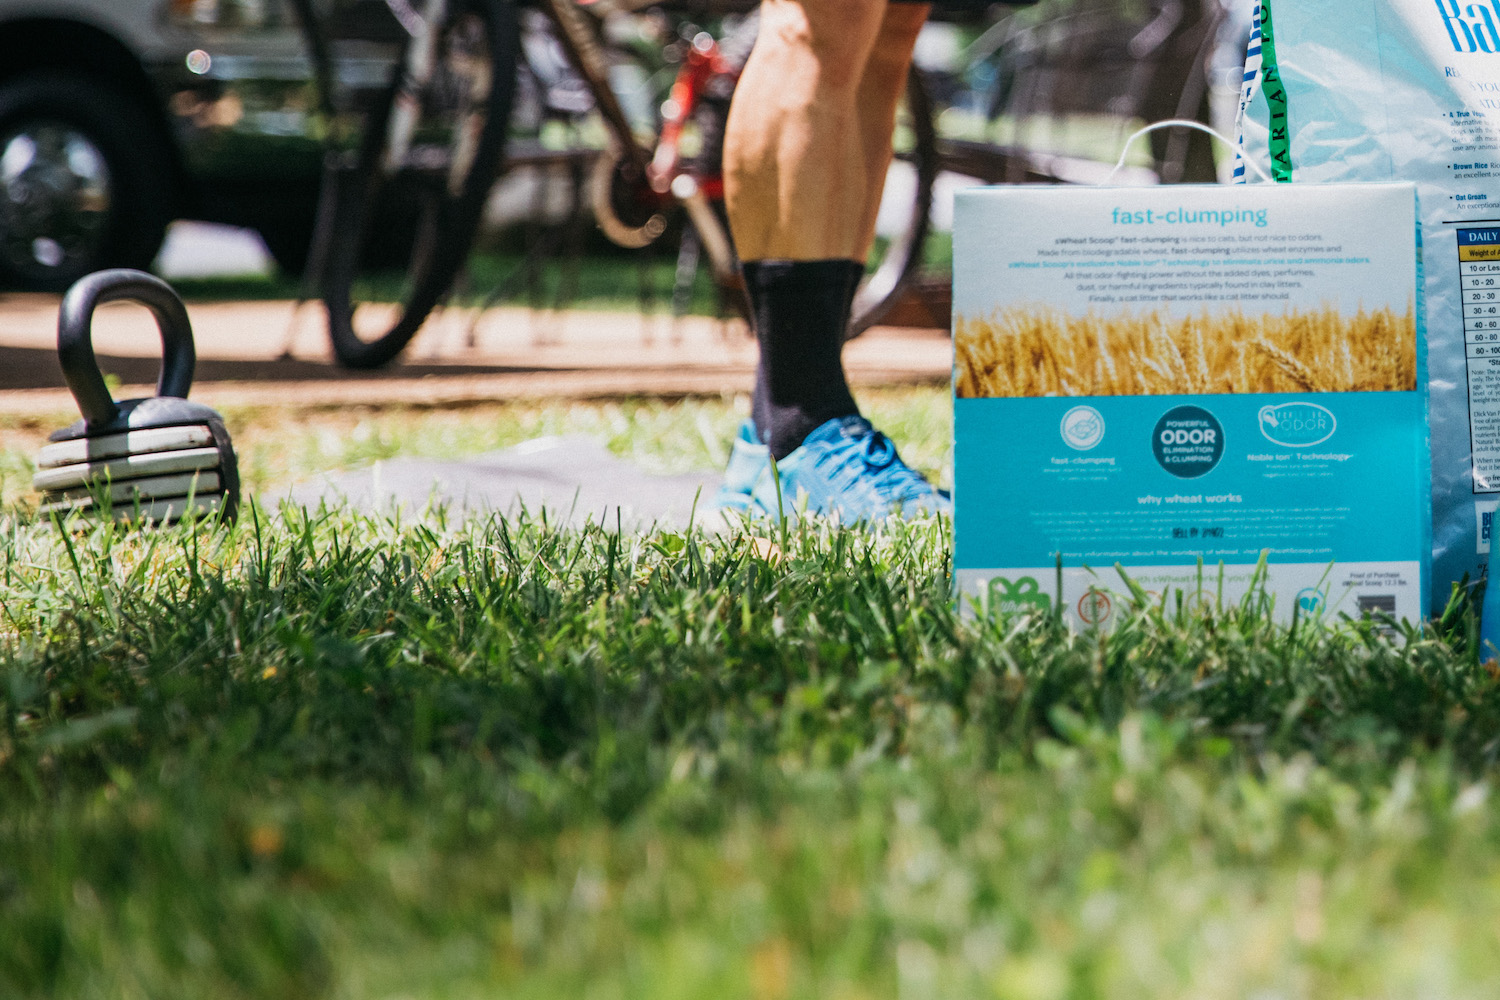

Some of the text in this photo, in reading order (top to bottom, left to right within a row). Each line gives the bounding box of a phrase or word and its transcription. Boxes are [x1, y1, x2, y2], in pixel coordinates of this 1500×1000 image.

[1466, 202, 1500, 210] exceptional
[1112, 206, 1268, 227] fast-clumping
[1469, 232, 1497, 242] DAILY
[1166, 420, 1209, 428] POWERFUL
[1160, 430, 1216, 445] ODOR
[1163, 446, 1214, 454] ELIMINATION
[1172, 455, 1212, 463] CLUMPING
[1138, 493, 1242, 506] why wheat works
